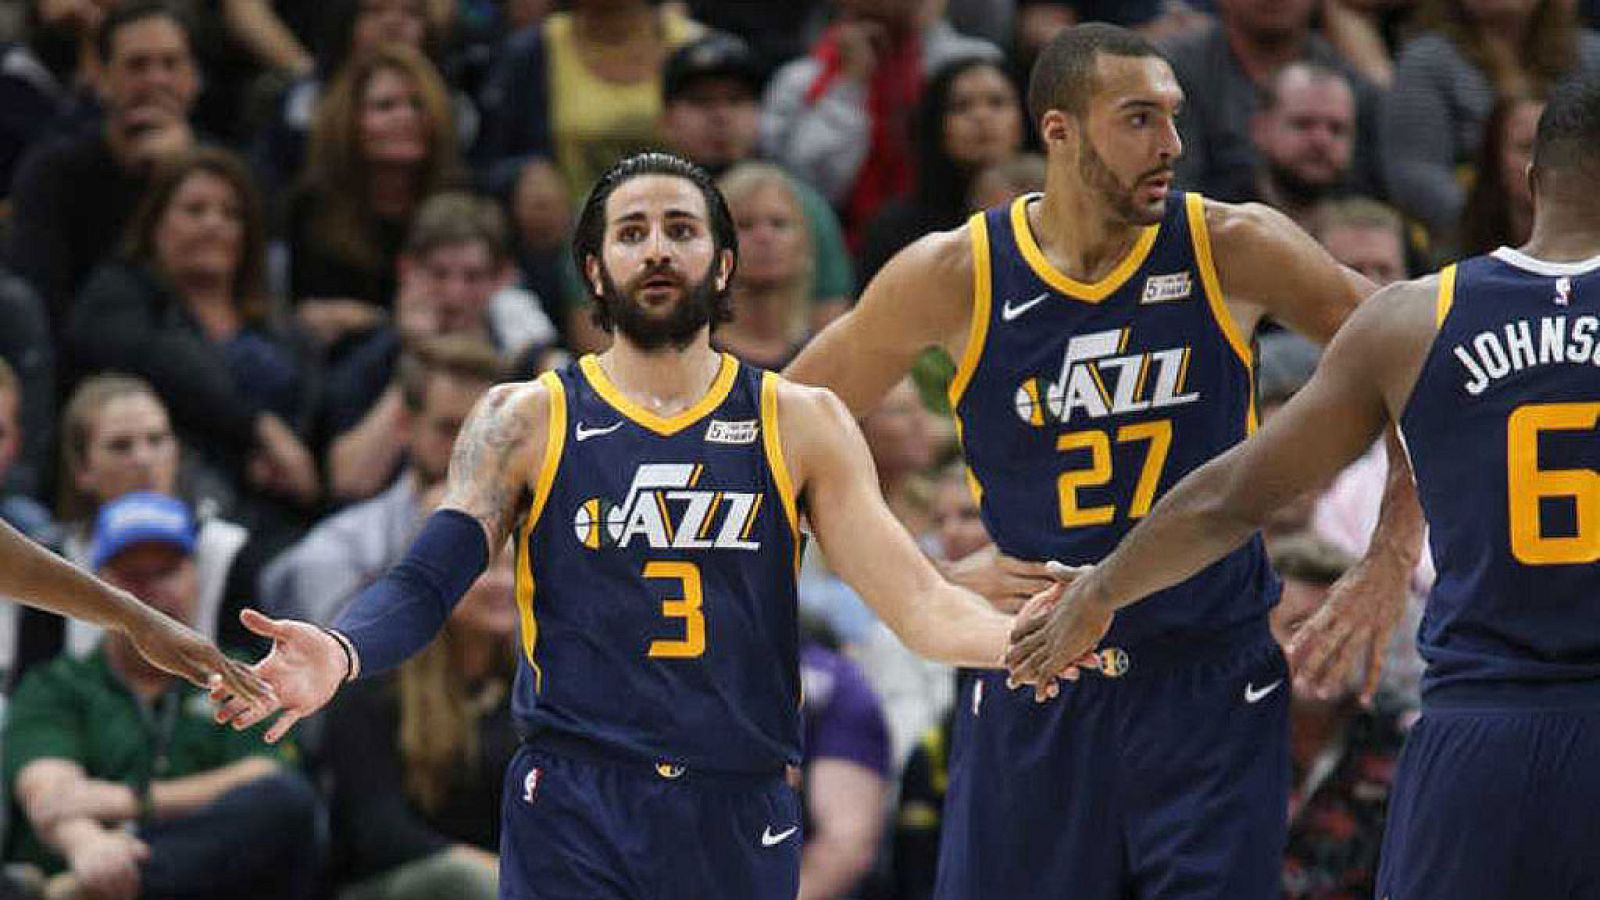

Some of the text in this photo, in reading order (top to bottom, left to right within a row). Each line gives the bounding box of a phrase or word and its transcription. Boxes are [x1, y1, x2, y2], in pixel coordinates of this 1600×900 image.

[1015, 327, 1200, 426] JAZZ
[575, 463, 763, 550] JAZZ
[1056, 418, 1173, 528] 27
[1508, 402, 1600, 565] 6
[641, 561, 706, 658] 3
